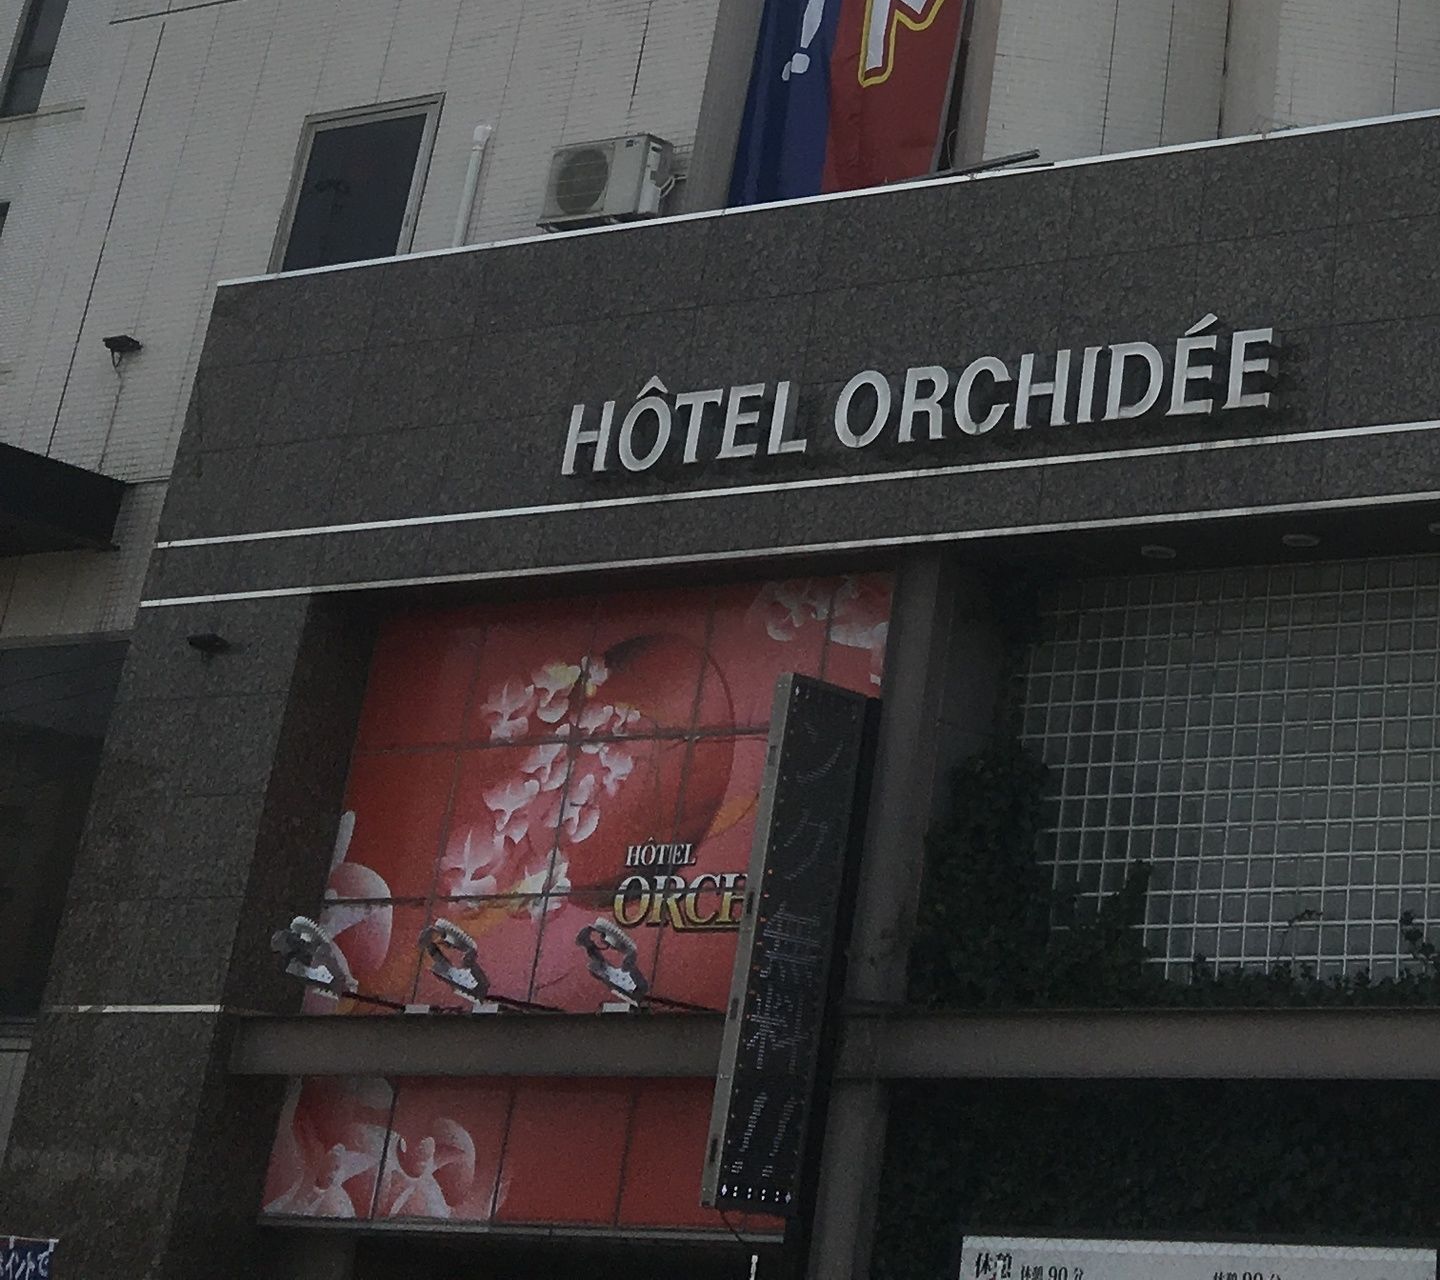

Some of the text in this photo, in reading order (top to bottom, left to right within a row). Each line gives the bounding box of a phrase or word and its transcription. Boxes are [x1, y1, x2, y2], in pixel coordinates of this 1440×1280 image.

[561, 313, 1273, 476] HÔTEL ORCHIDÉE
[626, 837, 697, 867] HÔTEL
